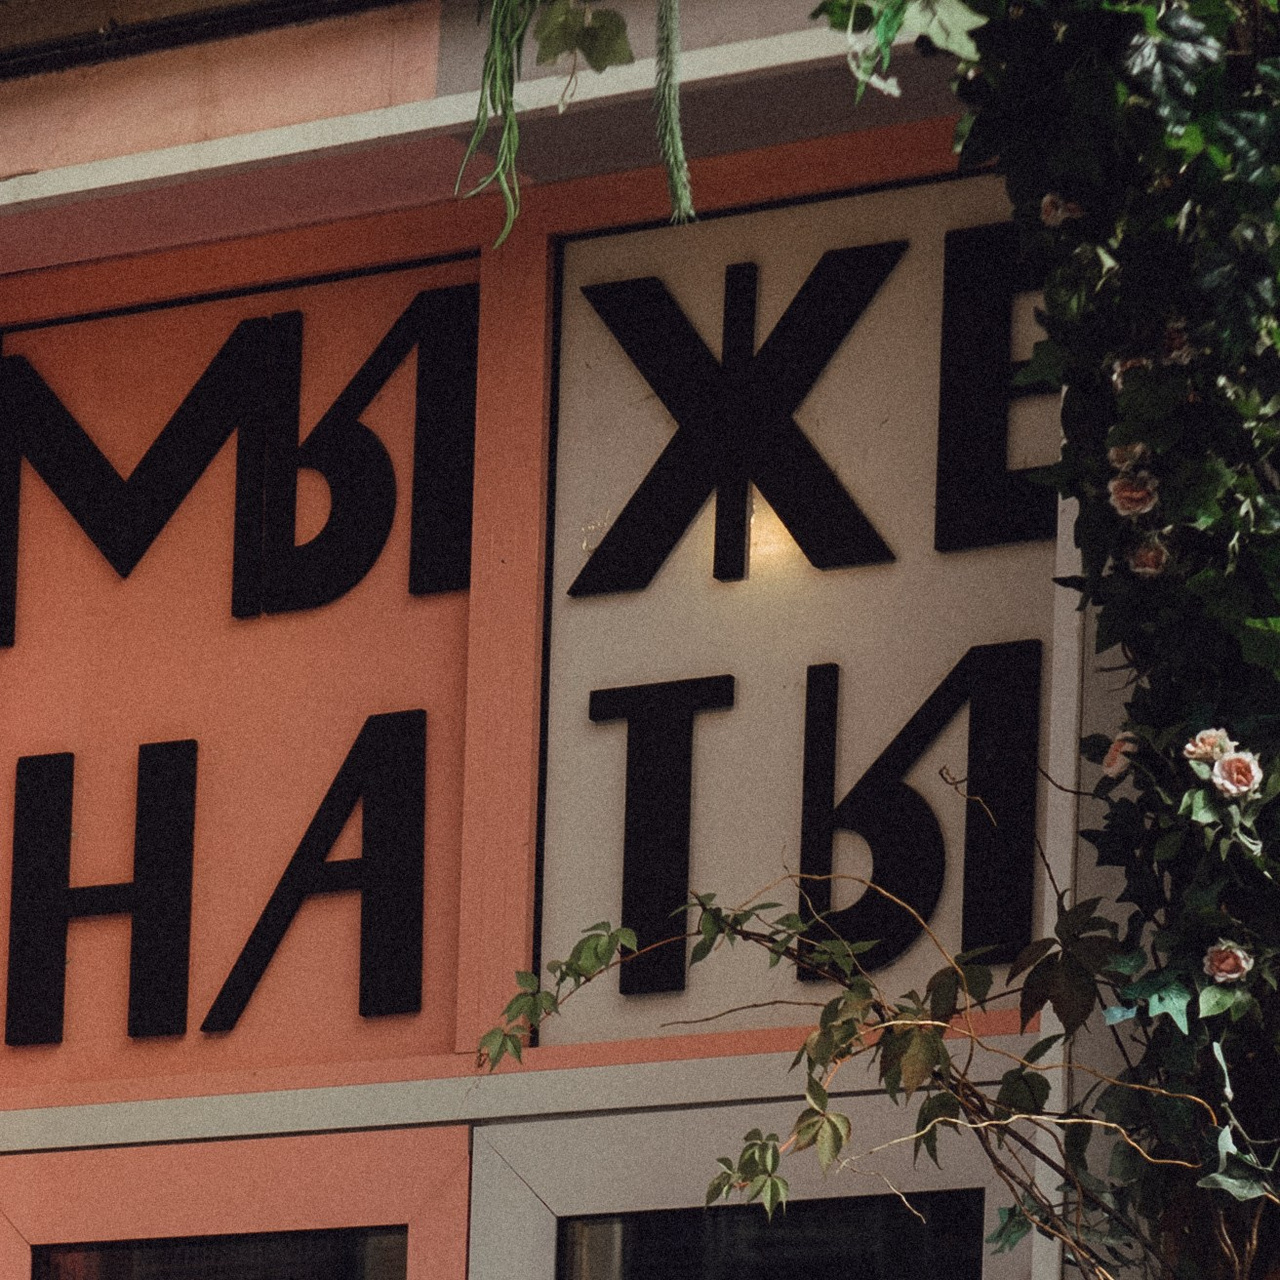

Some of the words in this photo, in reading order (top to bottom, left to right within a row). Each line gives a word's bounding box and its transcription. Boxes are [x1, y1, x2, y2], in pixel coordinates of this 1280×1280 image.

[568, 222, 1062, 596] ЖЕ
[4, 708, 427, 1046] НА
[586, 638, 1043, 996] ТЫ
